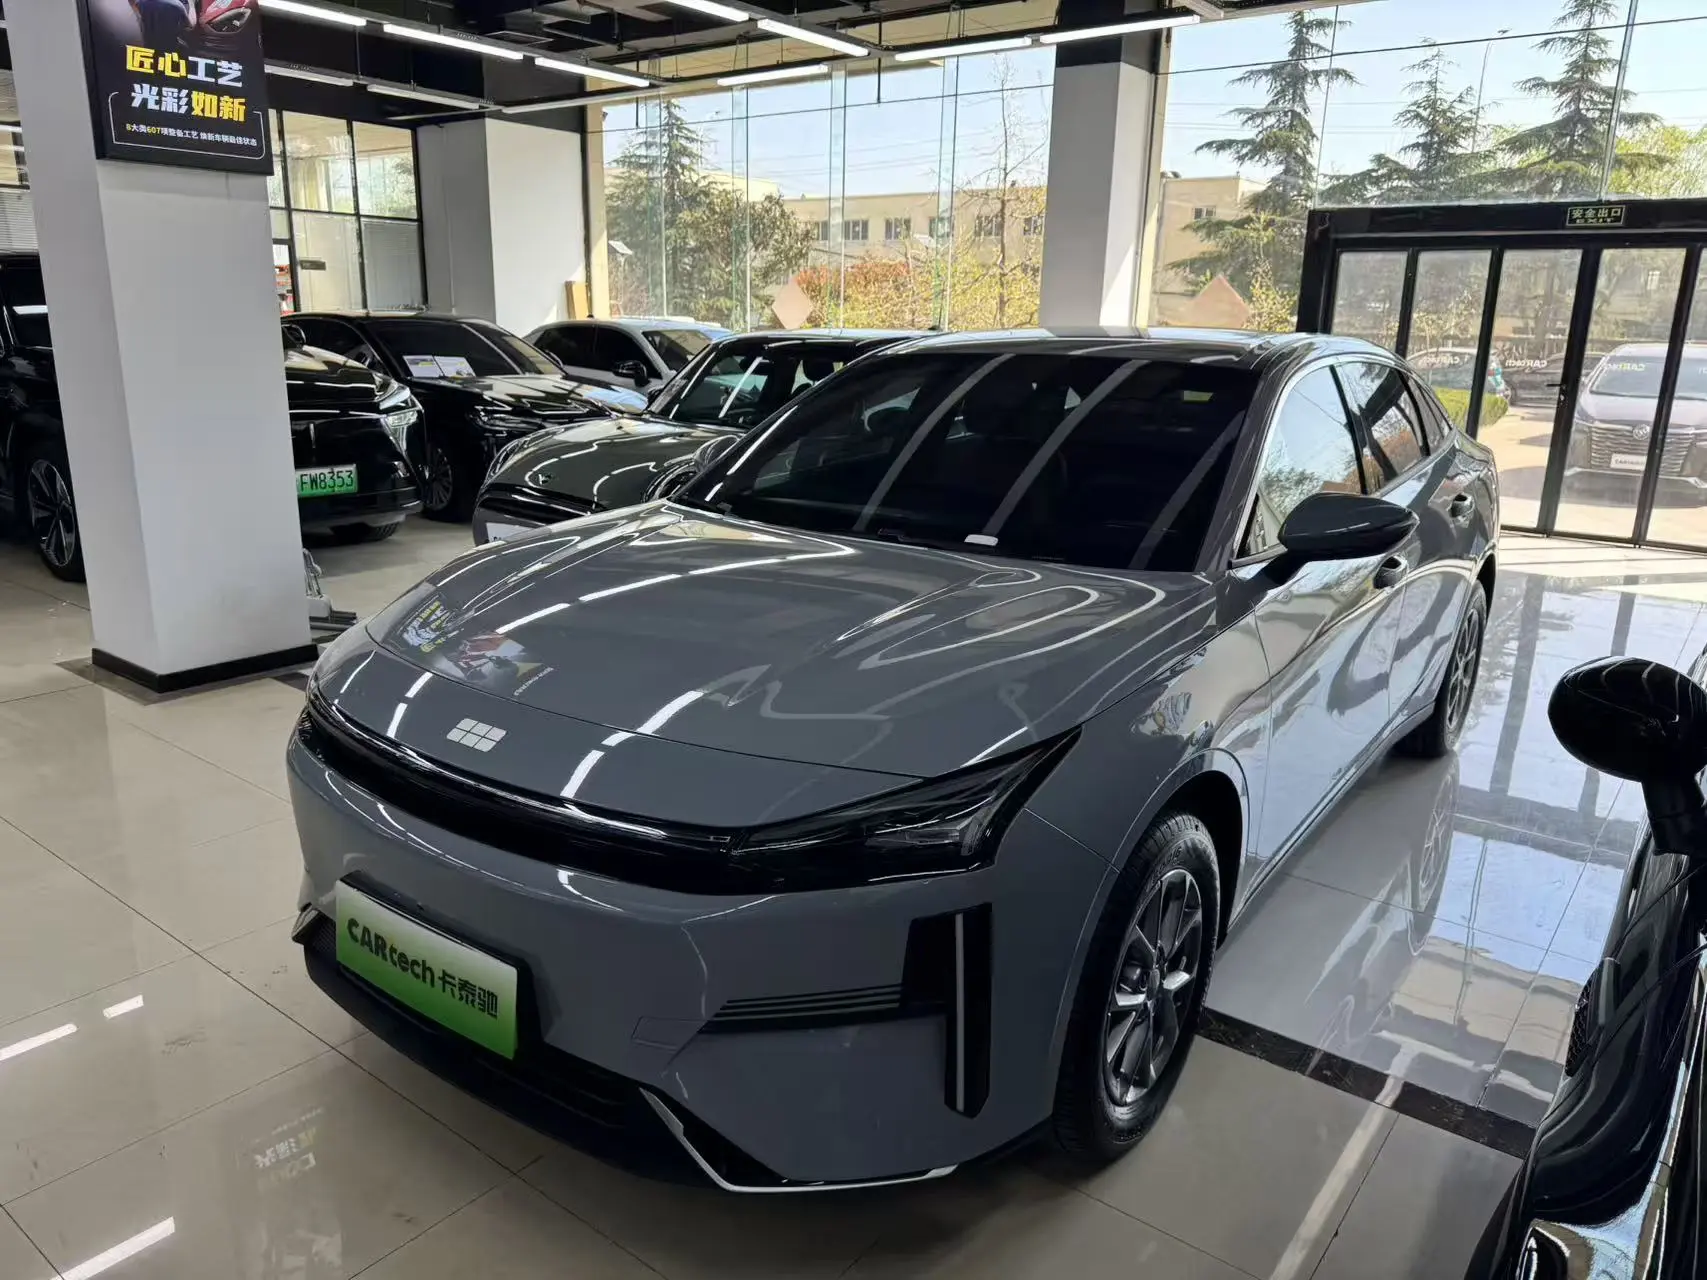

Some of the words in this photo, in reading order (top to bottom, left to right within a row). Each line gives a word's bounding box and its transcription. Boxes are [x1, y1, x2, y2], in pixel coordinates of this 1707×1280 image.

[126, 45, 243, 87] 匠心工艺
[131, 83, 246, 122] 光彩如新
[1571, 208, 1621, 219] 安全出口
[300, 470, 354, 491] FW8353
